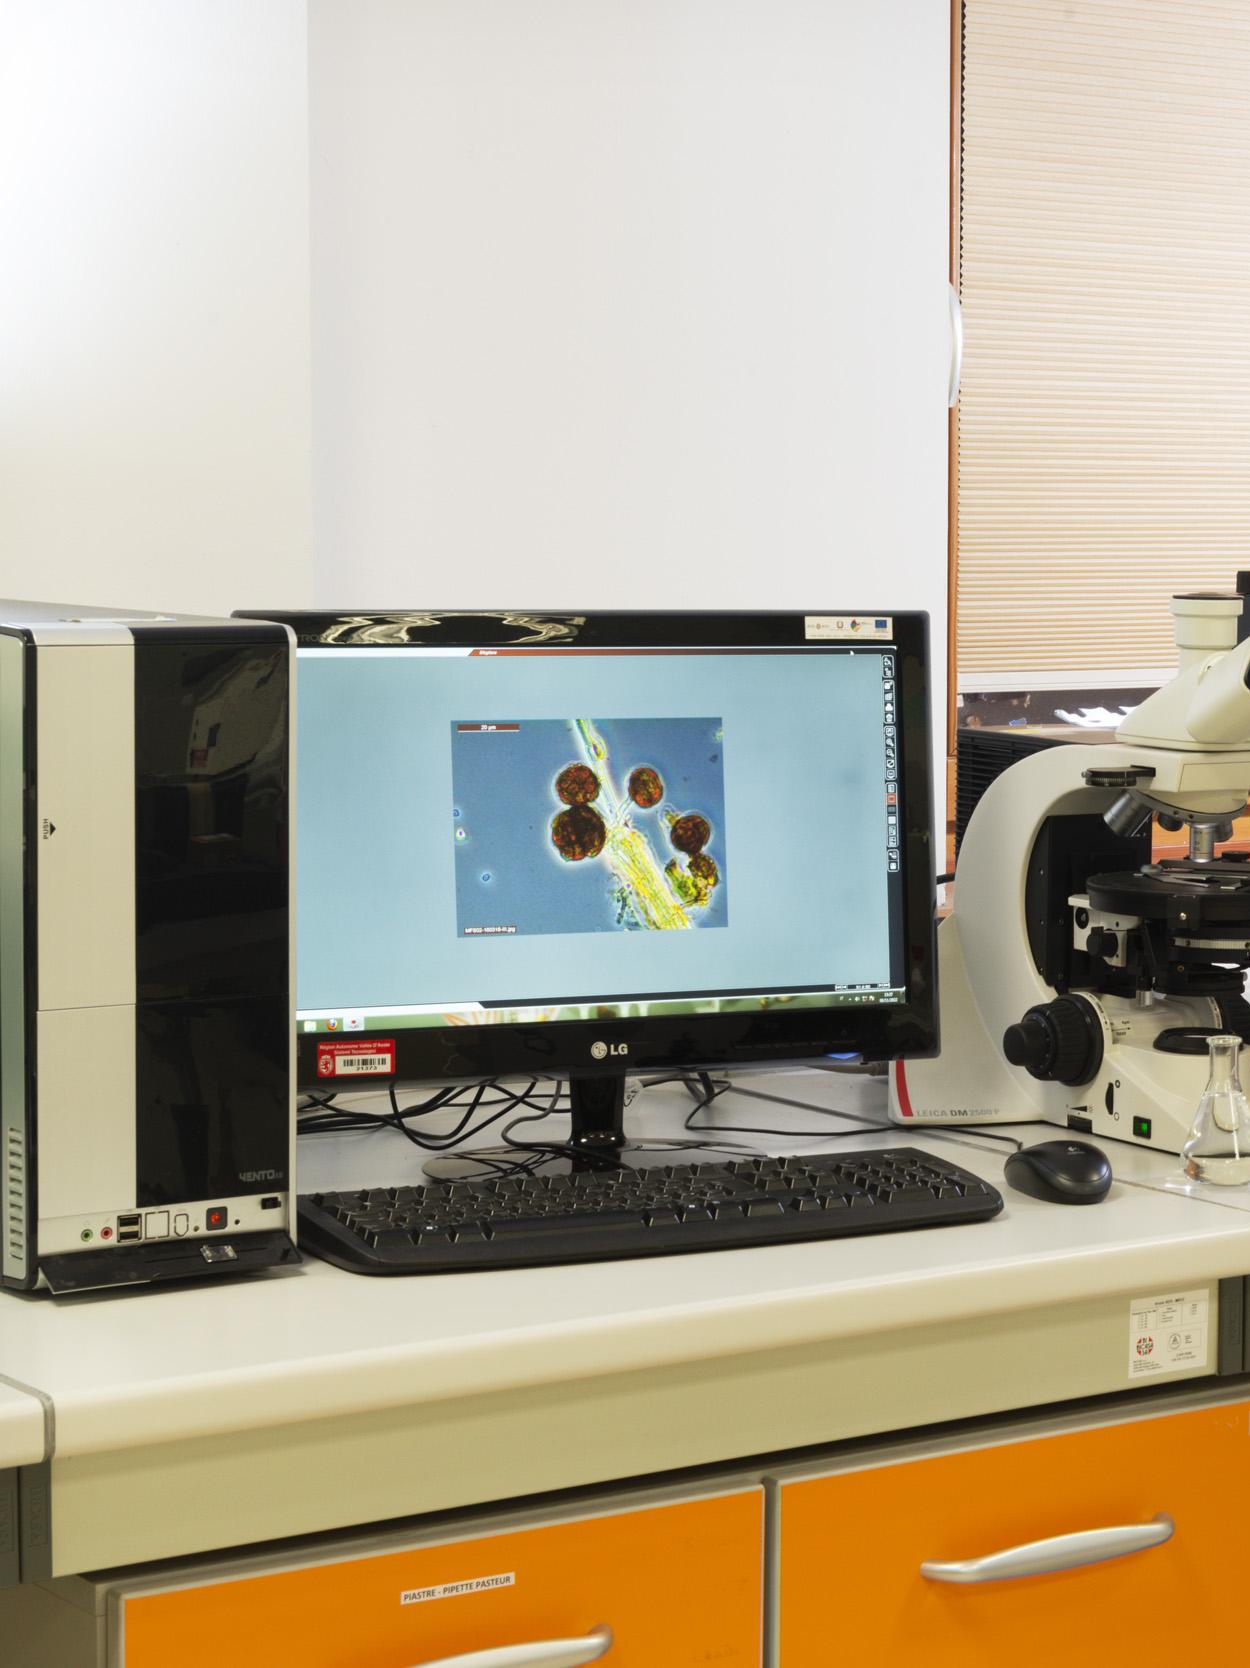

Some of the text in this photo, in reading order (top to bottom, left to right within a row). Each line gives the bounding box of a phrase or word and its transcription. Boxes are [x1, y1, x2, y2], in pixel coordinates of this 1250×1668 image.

[610, 1043, 628, 1055] LG
[917, 1109, 947, 1117] LEICA
[403, 1588, 436, 1602] PIASTRE
[442, 1582, 474, 1595] PIPETTE
[475, 1575, 511, 1589] PASTEUR
